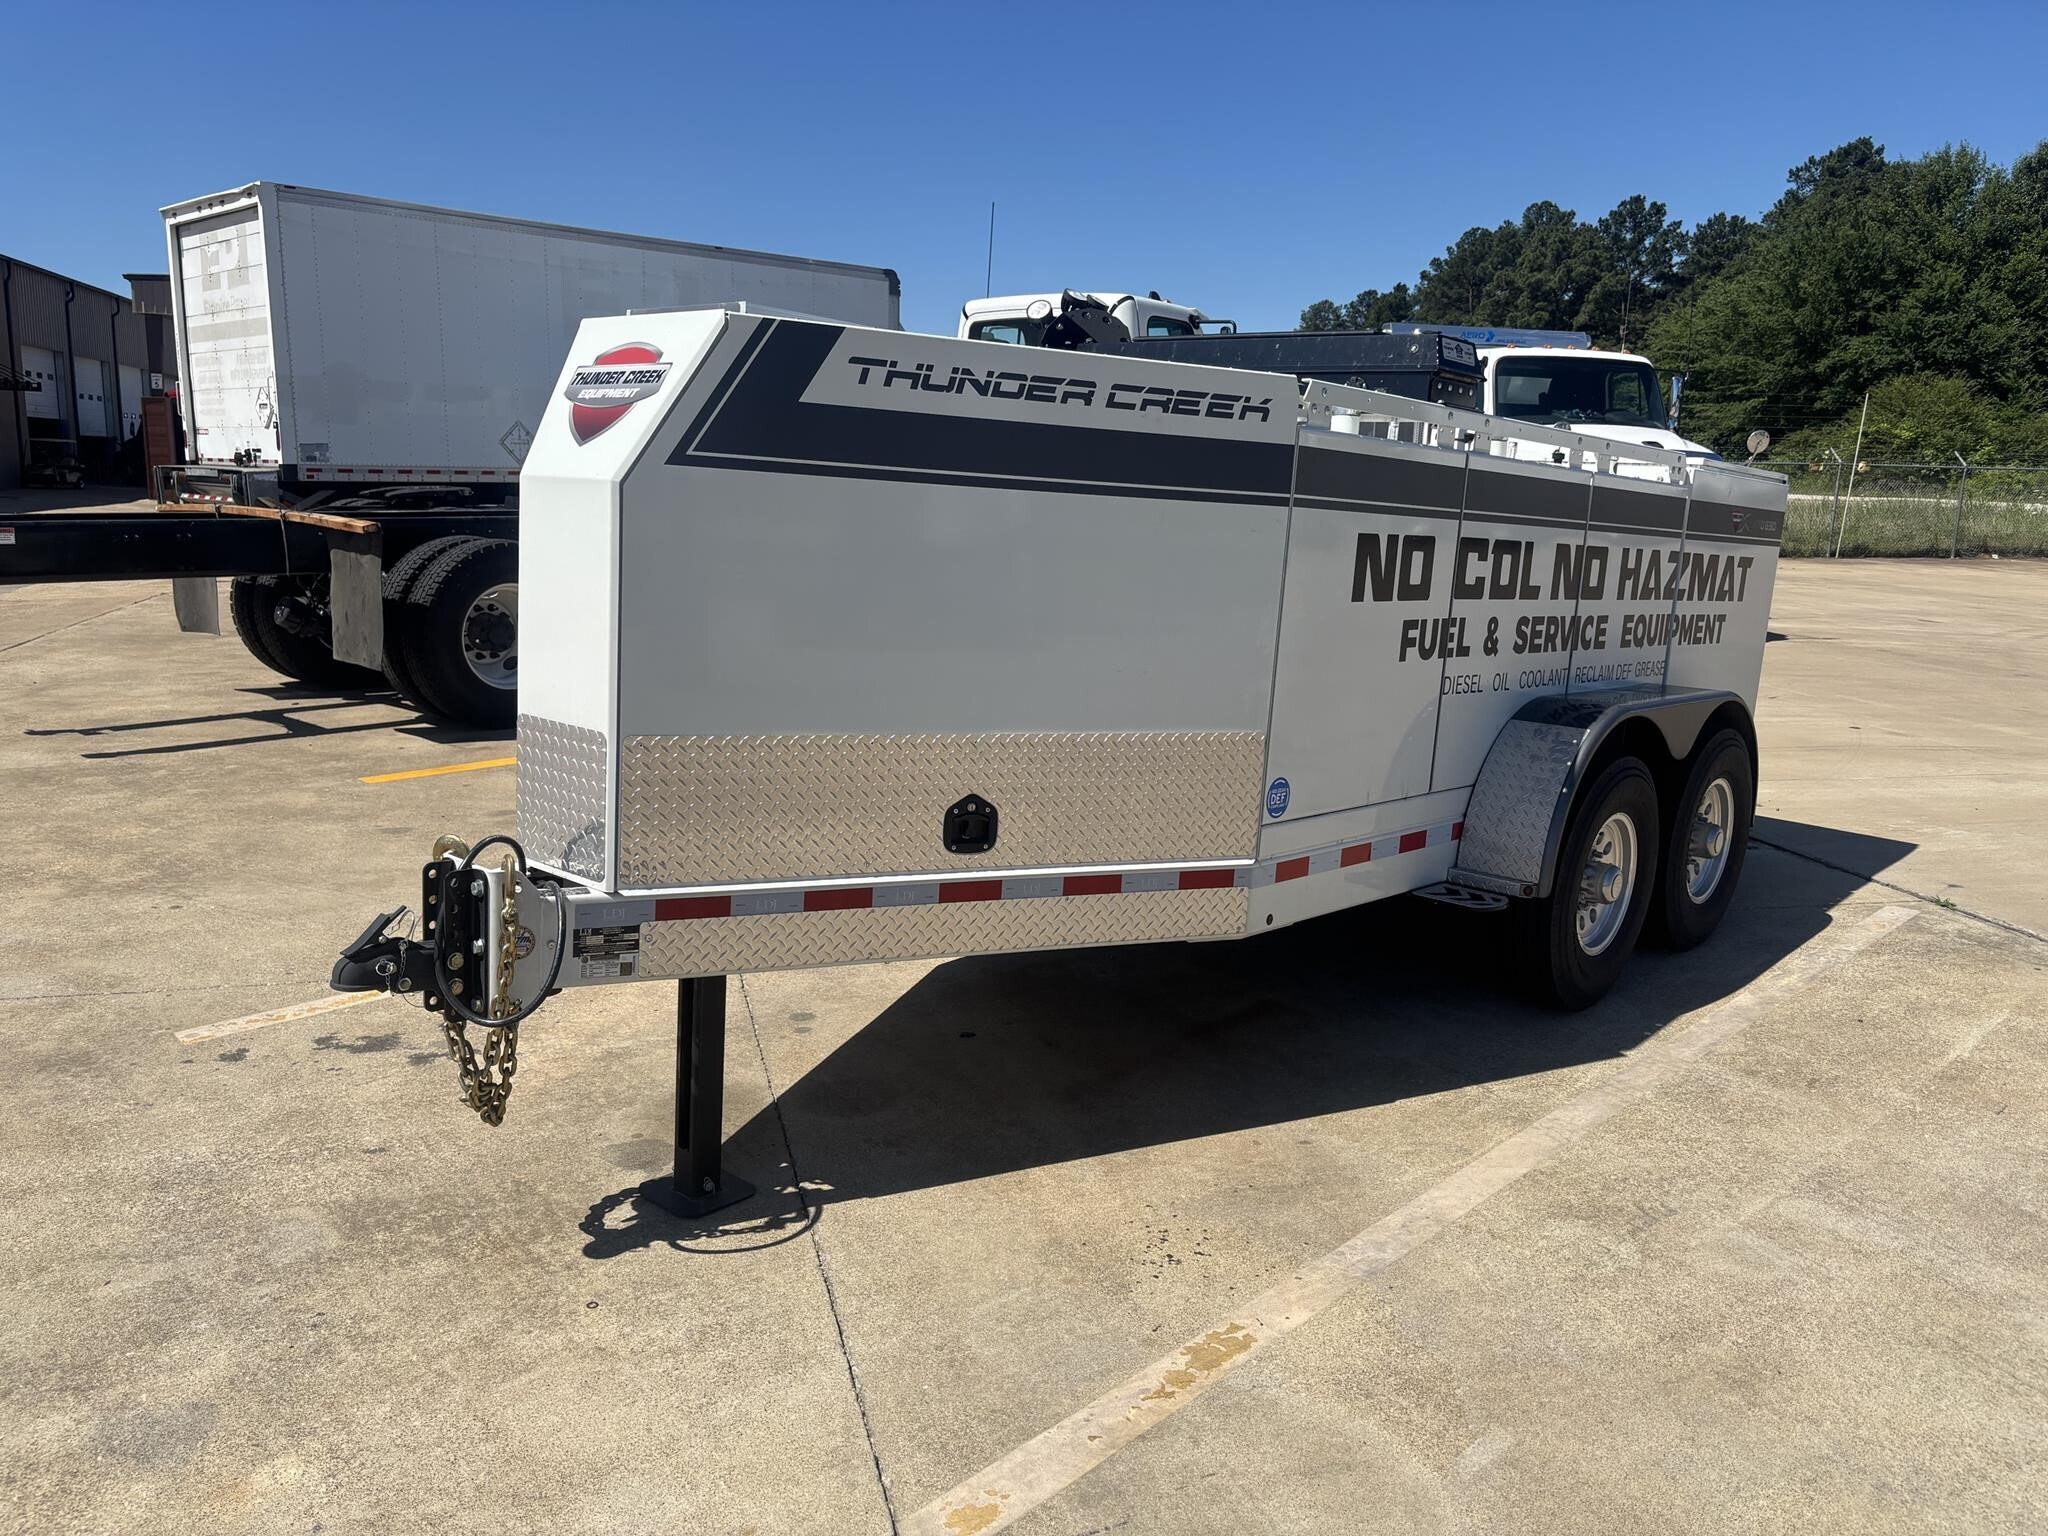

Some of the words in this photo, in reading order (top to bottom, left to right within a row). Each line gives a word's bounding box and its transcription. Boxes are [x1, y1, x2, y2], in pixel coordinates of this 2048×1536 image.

[1460, 330, 1485, 340] AERO
[571, 370, 626, 386] THUNDER
[622, 369, 667, 384] CREEK
[847, 355, 1097, 407] THUNDER
[1105, 382, 1274, 423] CREEK
[577, 387, 640, 400] EQUIPMENT
[1351, 533, 1436, 602] NO
[1453, 537, 1541, 600] CDL
[1550, 543, 1609, 600] NO
[1616, 547, 1754, 602] HAZMAT
[1398, 617, 1471, 662] FUEL
[1483, 616, 1499, 657] &
[1512, 614, 1609, 654] SERVICE
[1620, 613, 1727, 650] EQUIPMENT
[1442, 674, 1483, 695] DIESEL
[1492, 672, 1510, 692] OIL
[1519, 667, 1569, 689] COOLANT
[1575, 664, 1615, 684] RECLAIM
[1615, 663, 1633, 680] DEF
[1634, 660, 1665, 677] GREASE
[1271, 793, 1286, 804] DEF
